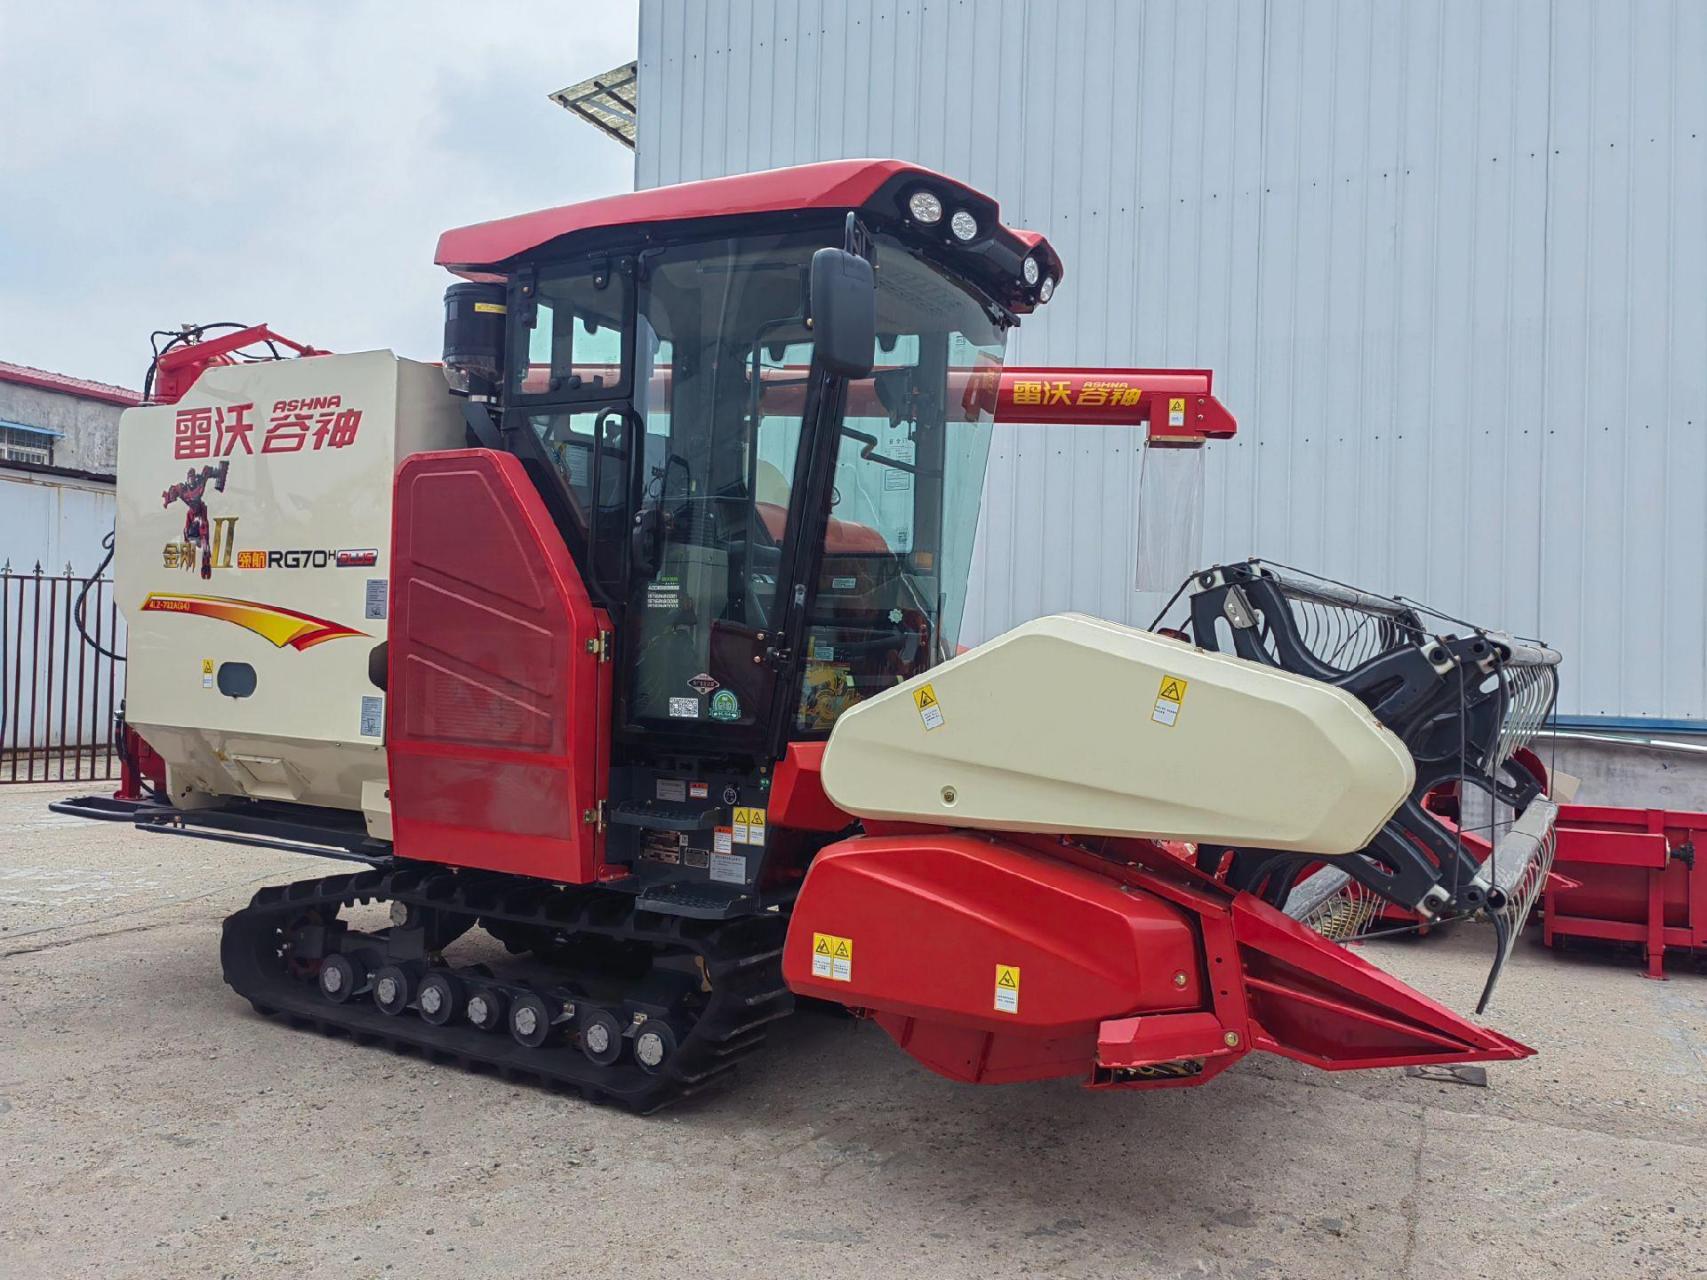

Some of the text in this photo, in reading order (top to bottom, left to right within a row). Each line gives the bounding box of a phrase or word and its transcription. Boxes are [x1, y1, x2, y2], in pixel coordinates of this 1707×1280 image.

[1013, 381, 1142, 407] 雷沃谷神
[1083, 381, 1129, 389] ASHNA
[273, 395, 341, 413] ASHNA
[174, 402, 363, 460] 雷沃谷神
